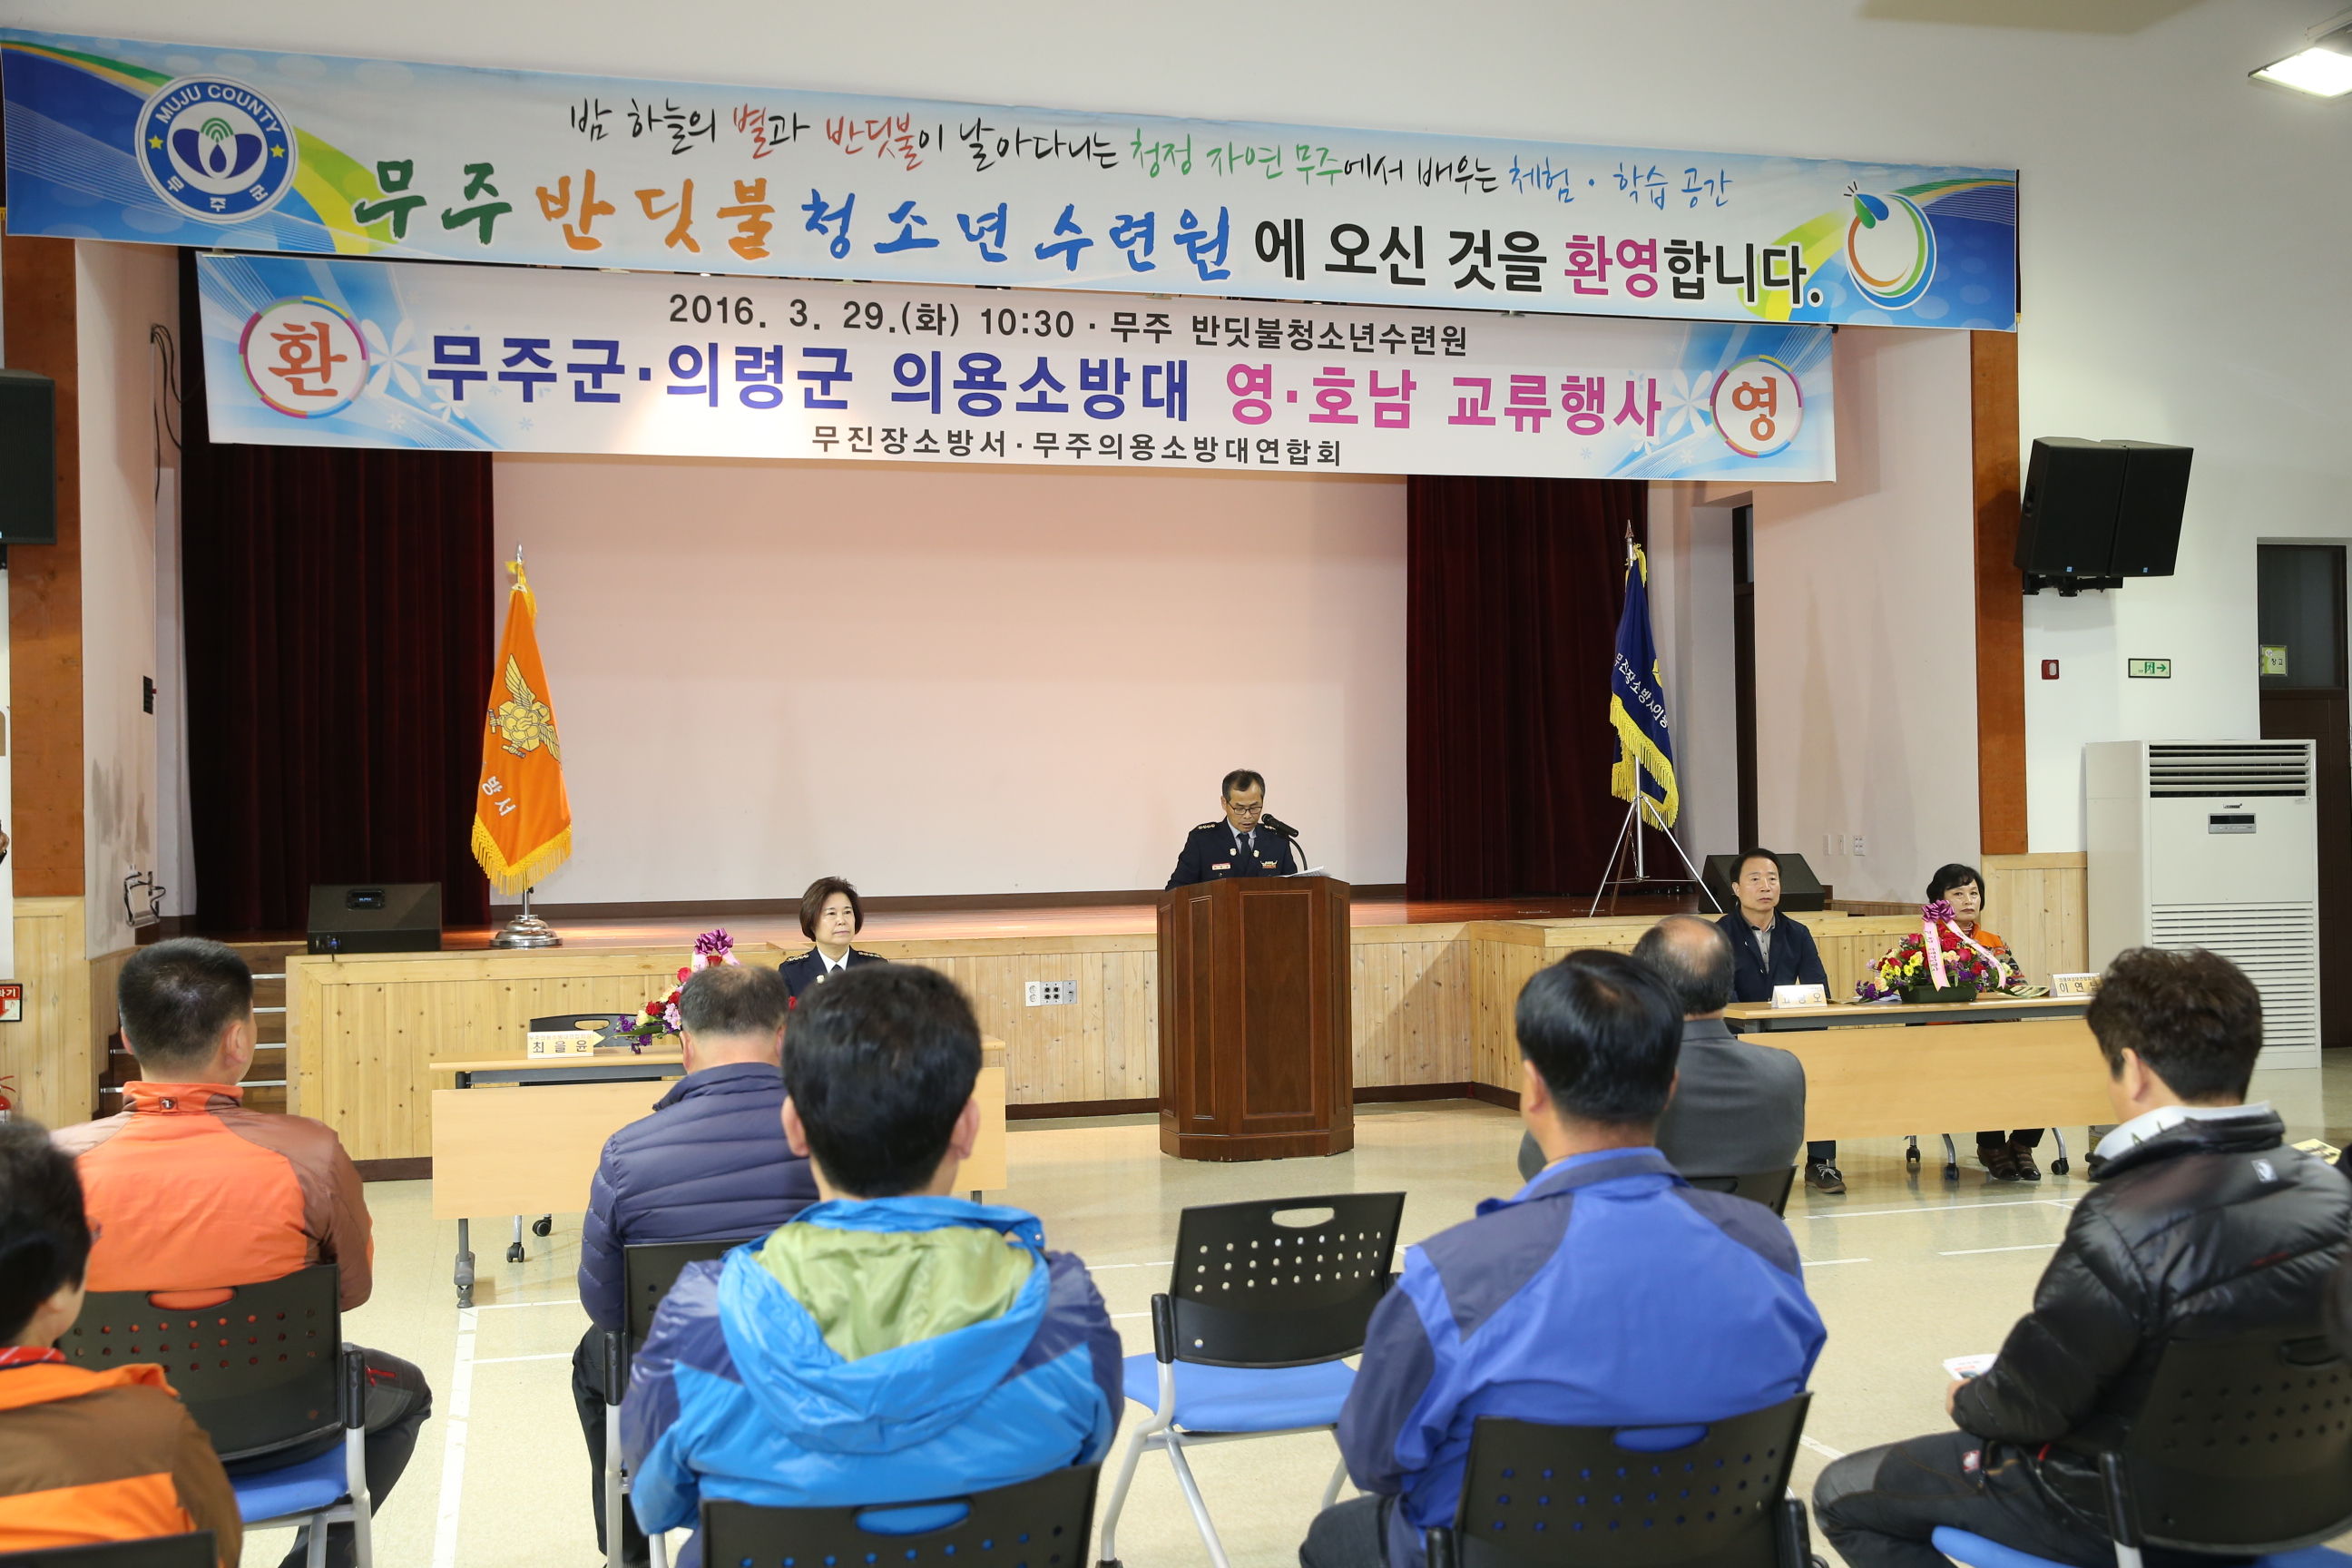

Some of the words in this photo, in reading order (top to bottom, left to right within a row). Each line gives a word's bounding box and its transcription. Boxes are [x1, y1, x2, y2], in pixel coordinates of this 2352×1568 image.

[155, 85, 201, 124] MUJU
[208, 84, 281, 133] COUNTY
[572, 99, 612, 142] 밤
[627, 98, 715, 155] 하늘의
[734, 104, 810, 159] 별과
[827, 113, 943, 171] 반딧불이
[960, 117, 1119, 172] 날아다니는
[1131, 128, 1191, 178] 청정
[1207, 142, 1282, 179] 자연
[1297, 144, 1402, 186] 무주에서
[1418, 155, 1498, 194] 배우는
[1509, 155, 1574, 203] 체험
[1613, 162, 1668, 210] 학습
[1681, 168, 1732, 208] 공간
[355, 160, 512, 245] 무주
[535, 170, 775, 260] 반딧불
[1325, 223, 1426, 286] 오신
[1448, 230, 1547, 292] 것을
[1564, 235, 1819, 307] 환영합니다.
[269, 321, 348, 397] 환
[670, 294, 766, 328] 2016.
[789, 299, 819, 330] 3.
[844, 301, 958, 337] 29.(화)
[981, 309, 1073, 338] 10:30
[1111, 312, 1171, 344] 무주
[1192, 316, 1465, 357] 반딧불청소년수련원
[891, 351, 1187, 421] 의용소방대
[1448, 375, 1665, 436] 교류행사
[1732, 377, 1777, 441] 영
[482, 761, 516, 817] 방서
